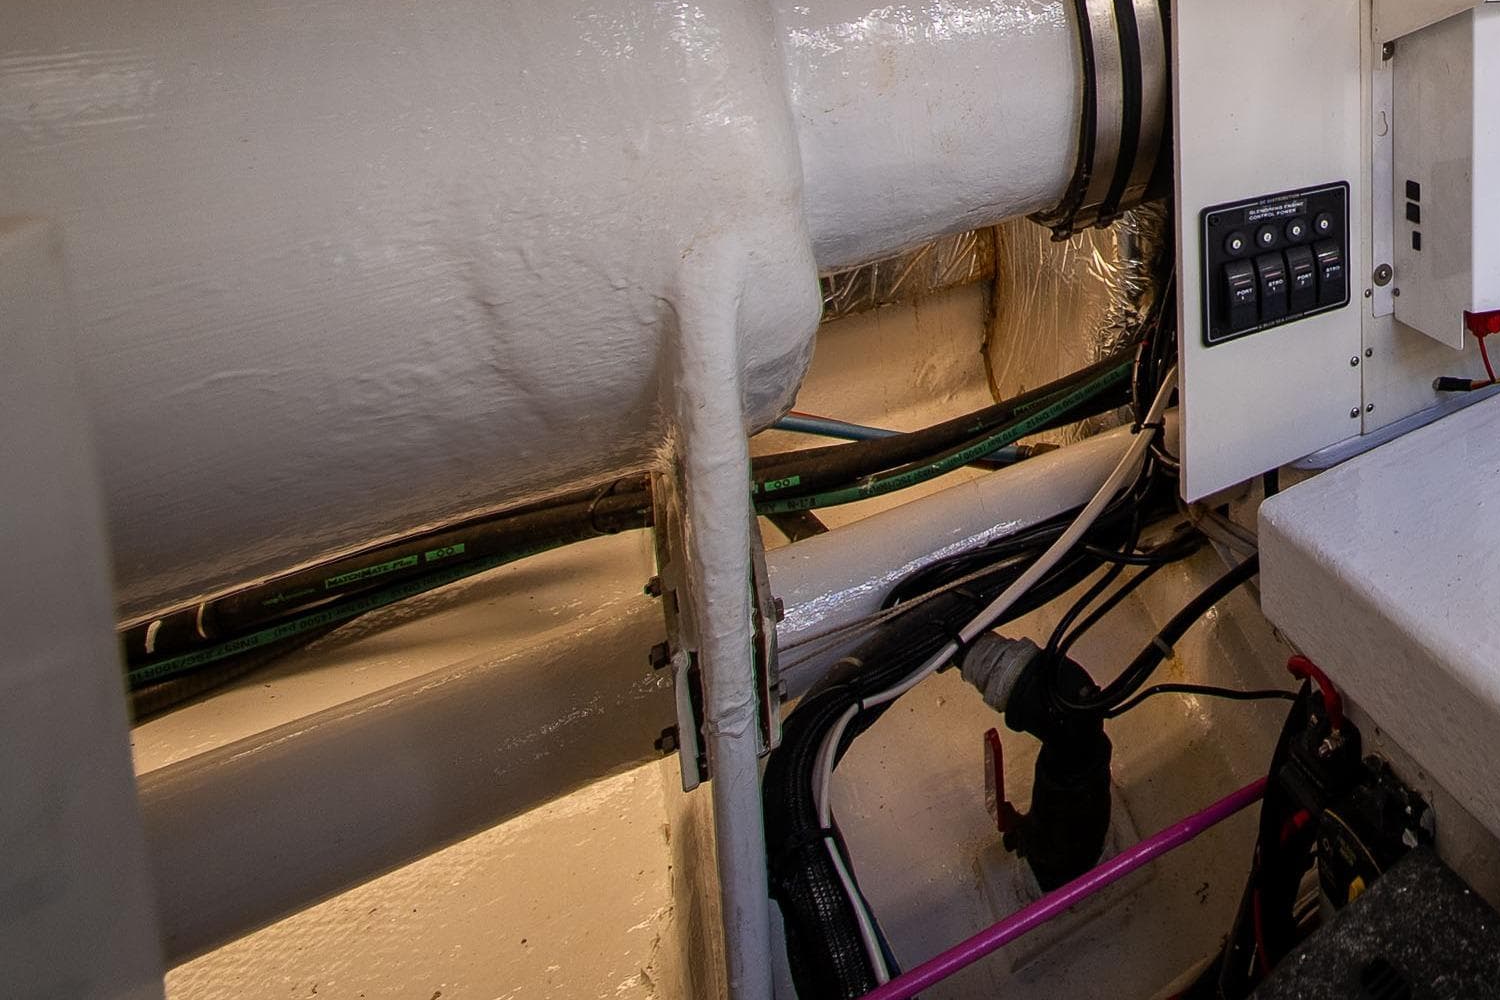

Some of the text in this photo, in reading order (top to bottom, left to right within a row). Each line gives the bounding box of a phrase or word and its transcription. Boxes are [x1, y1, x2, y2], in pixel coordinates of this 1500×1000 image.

[1248, 212, 1275, 221] CONTROL
[1297, 273, 1312, 281] PORT
[1236, 288, 1253, 296] PORT
